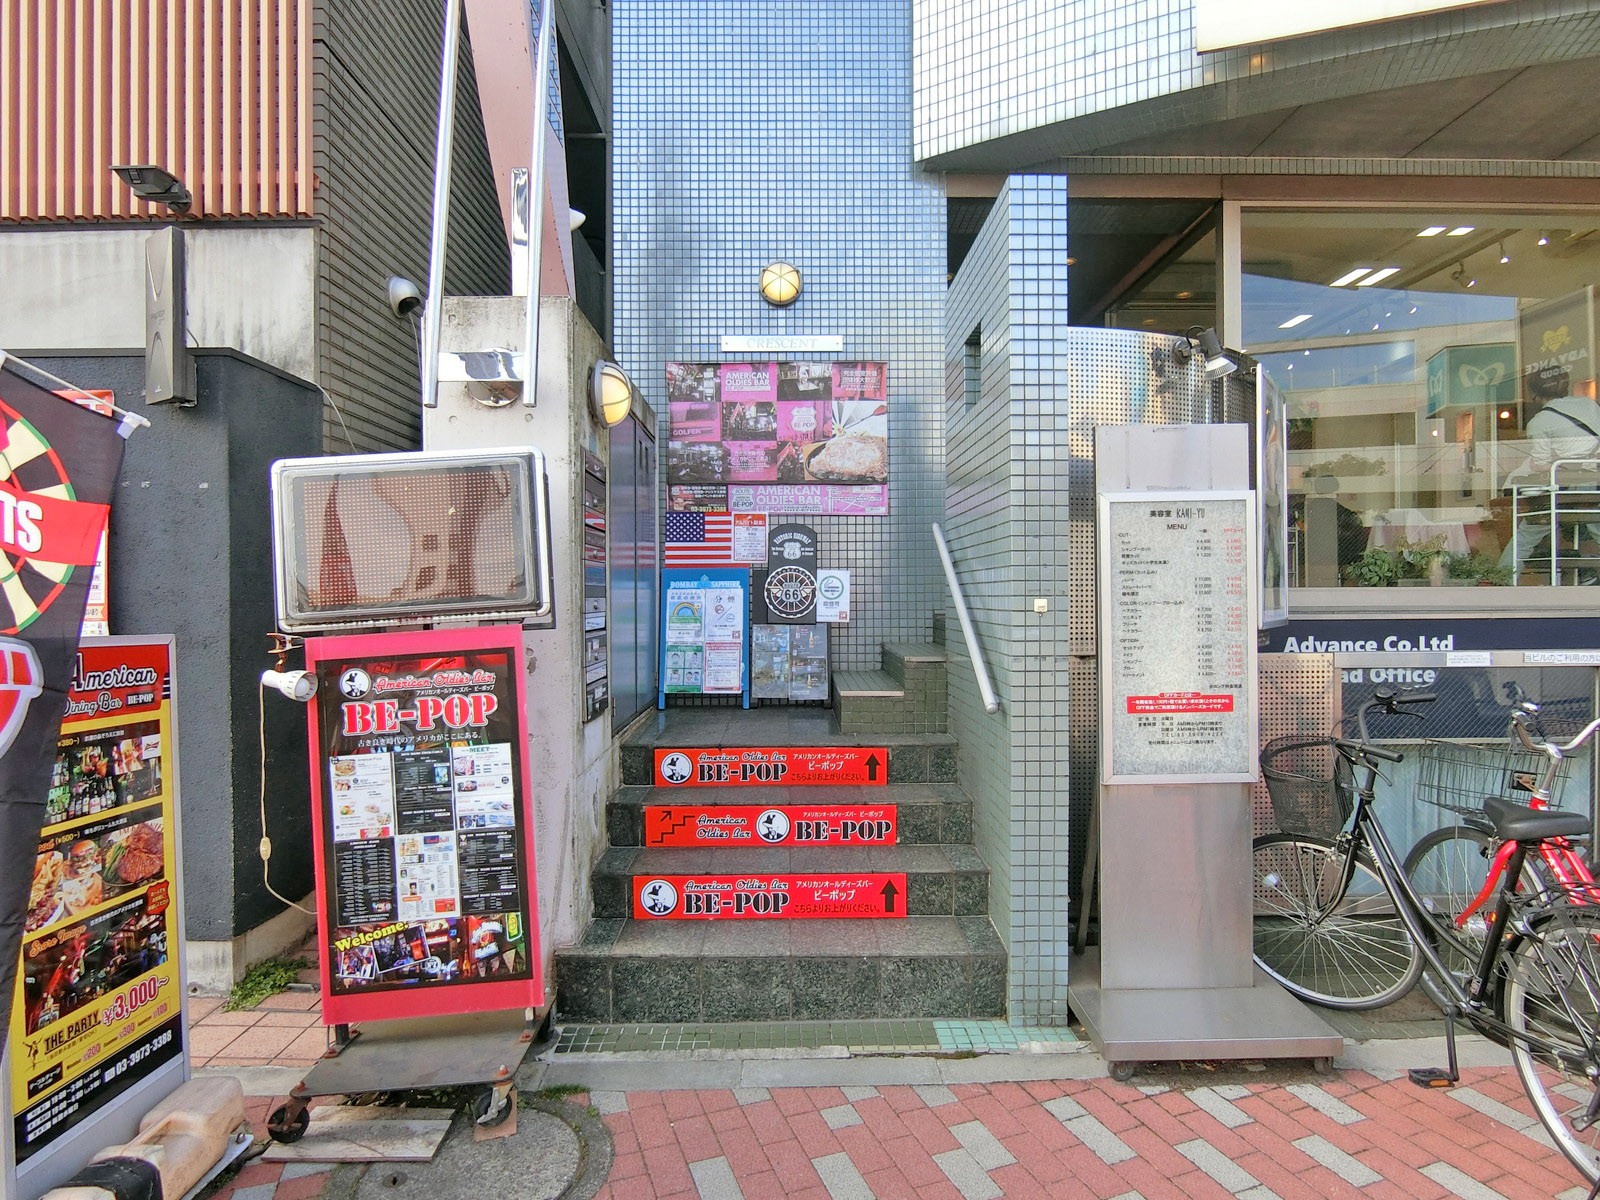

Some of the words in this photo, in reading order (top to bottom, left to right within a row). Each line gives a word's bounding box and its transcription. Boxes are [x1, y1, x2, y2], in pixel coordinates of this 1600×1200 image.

[747, 338, 818, 348] CRESCENT
[673, 428, 701, 436] GOLFER
[756, 496, 795, 505] OLDIES
[799, 496, 821, 505] BAR
[1150, 510, 1172, 518] 美容室
[785, 590, 799, 599] 66
[1283, 636, 1378, 652] Advance
[1383, 635, 1453, 652] Co.Ltd
[374, 676, 431, 692] American
[434, 673, 470, 685] Oldies
[473, 669, 495, 684] Bar
[98, 691, 122, 711] Bar
[127, 694, 153, 705] BE-POP
[343, 694, 498, 736] BE-POP
[698, 753, 739, 761] American
[742, 752, 768, 761] Oldies
[808, 761, 844, 770] ビーポップ
[698, 763, 788, 782] BE-POP
[791, 773, 865, 781] こちらよりお上がりください。
[696, 815, 747, 825] American
[696, 828, 730, 838] Oldies
[795, 820, 892, 840] BE-POP
[684, 881, 733, 891] American
[736, 879, 767, 890] Oldies
[814, 889, 856, 901] ビーポップ
[684, 893, 789, 913] BE-POP
[793, 904, 881, 913] こちらよりお上がりください。
[44, 1034, 65, 1053] THE
[67, 1010, 101, 1038] PARTY
[116, 1030, 172, 1076] 03-3973-3388
